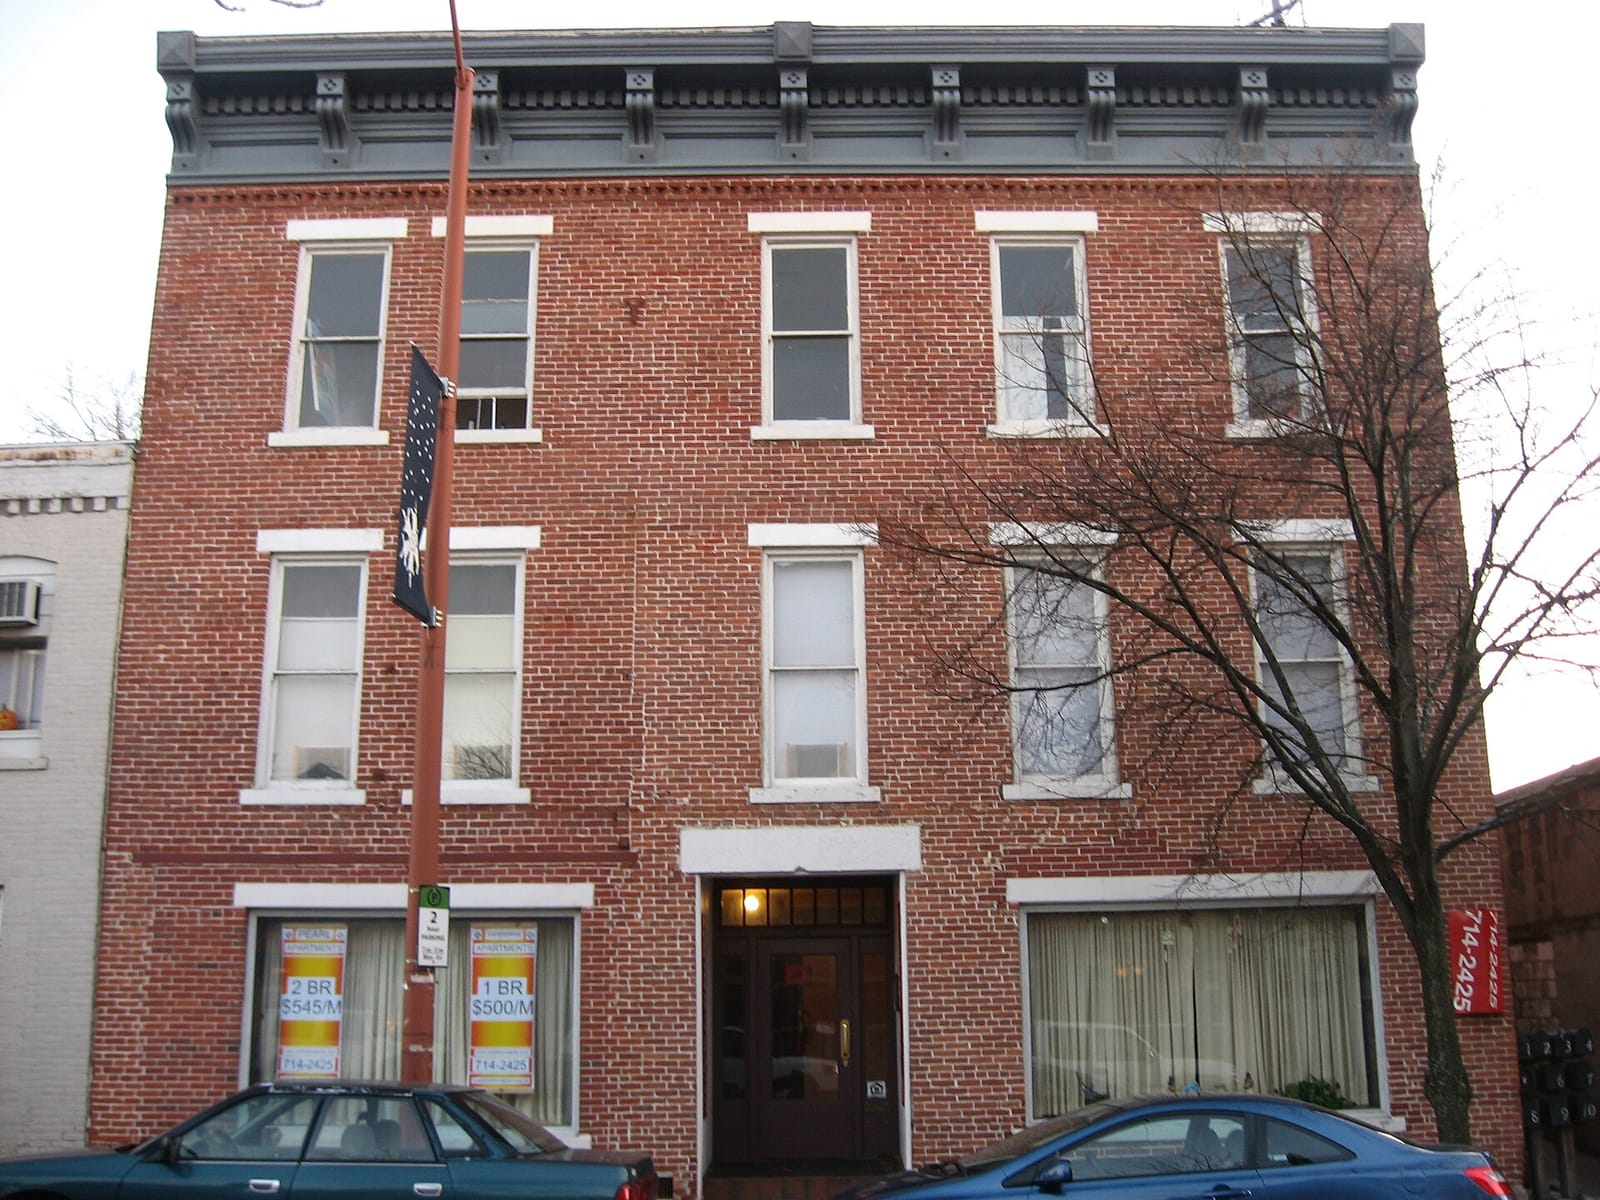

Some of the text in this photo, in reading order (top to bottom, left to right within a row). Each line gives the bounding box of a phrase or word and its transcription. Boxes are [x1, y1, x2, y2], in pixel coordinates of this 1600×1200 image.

[430, 911, 437, 924] 2
[287, 943, 345, 953] APARTMENTS
[475, 943, 535, 953] APARTMENTS
[1453, 910, 1483, 1012] 714-2425
[291, 979, 331, 995] 2 BR
[483, 980, 523, 995] 1 BR
[281, 999, 342, 1015] $545/M
[472, 999, 534, 1016] $500/M
[1543, 1041, 1552, 1055] 2
[1565, 1040, 1572, 1054] 3
[283, 1058, 334, 1070] 714-2425
[475, 1059, 528, 1071] 714-2425
[1557, 1073, 1565, 1088] 6
[1529, 1109, 1540, 1123] 8
[1560, 1106, 1569, 1120] 9
[1583, 1103, 1596, 1117] 10
